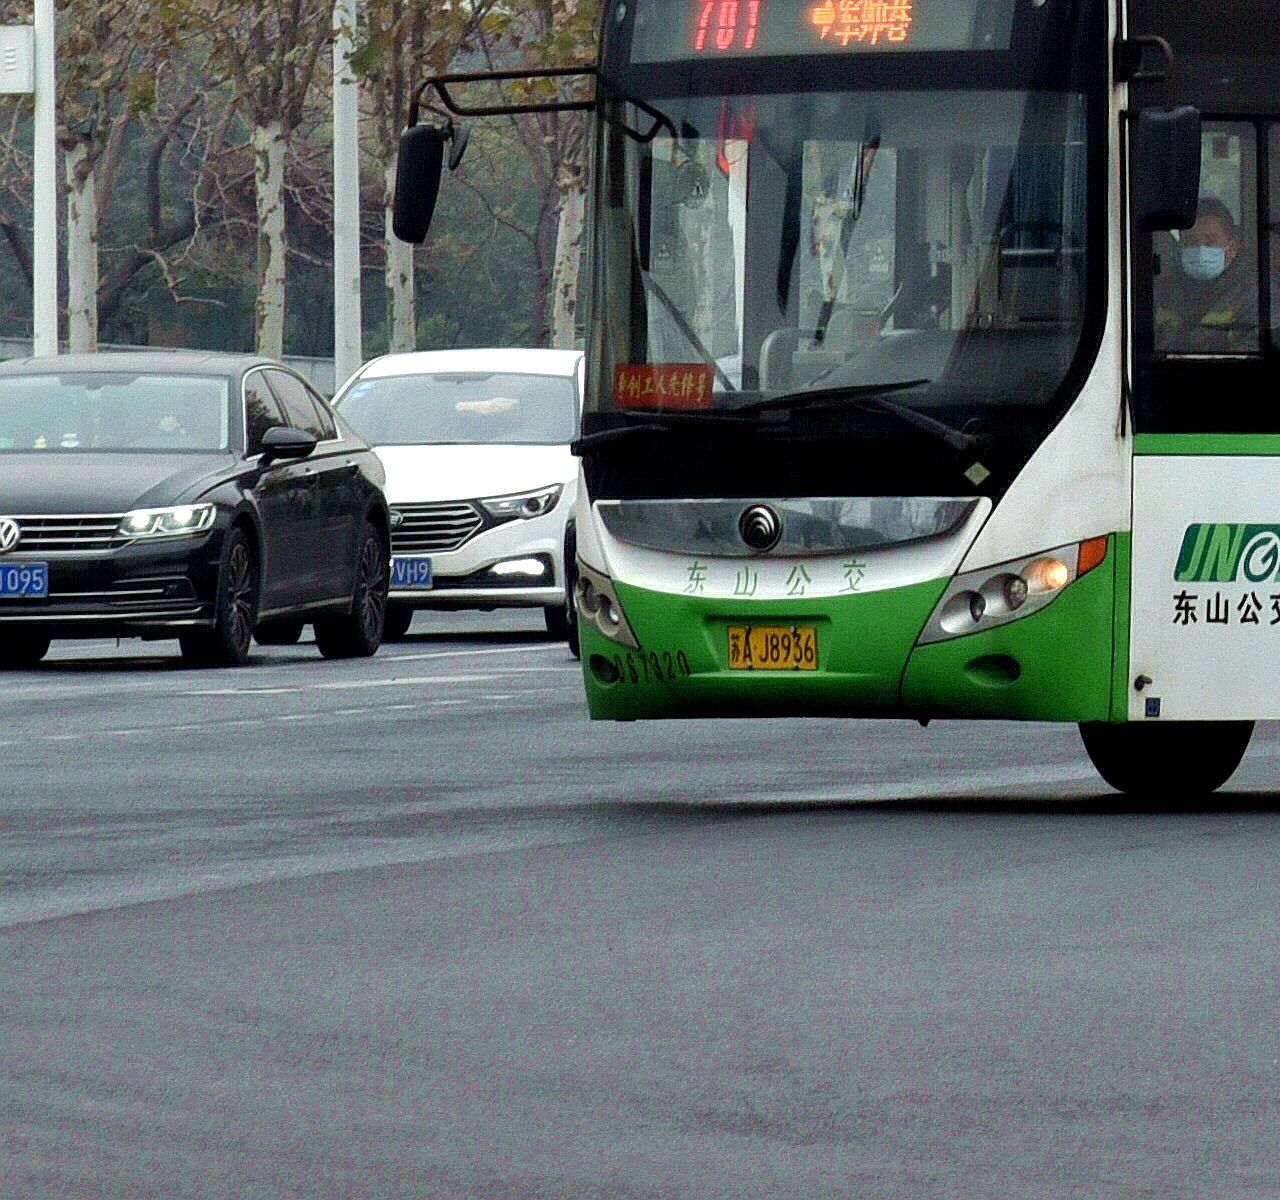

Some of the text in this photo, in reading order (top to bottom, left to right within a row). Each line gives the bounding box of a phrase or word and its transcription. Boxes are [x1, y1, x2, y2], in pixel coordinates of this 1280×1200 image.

[0, 569, 44, 593] 095
[390, 561, 429, 584] VH9
[683, 559, 867, 598] 东山公交
